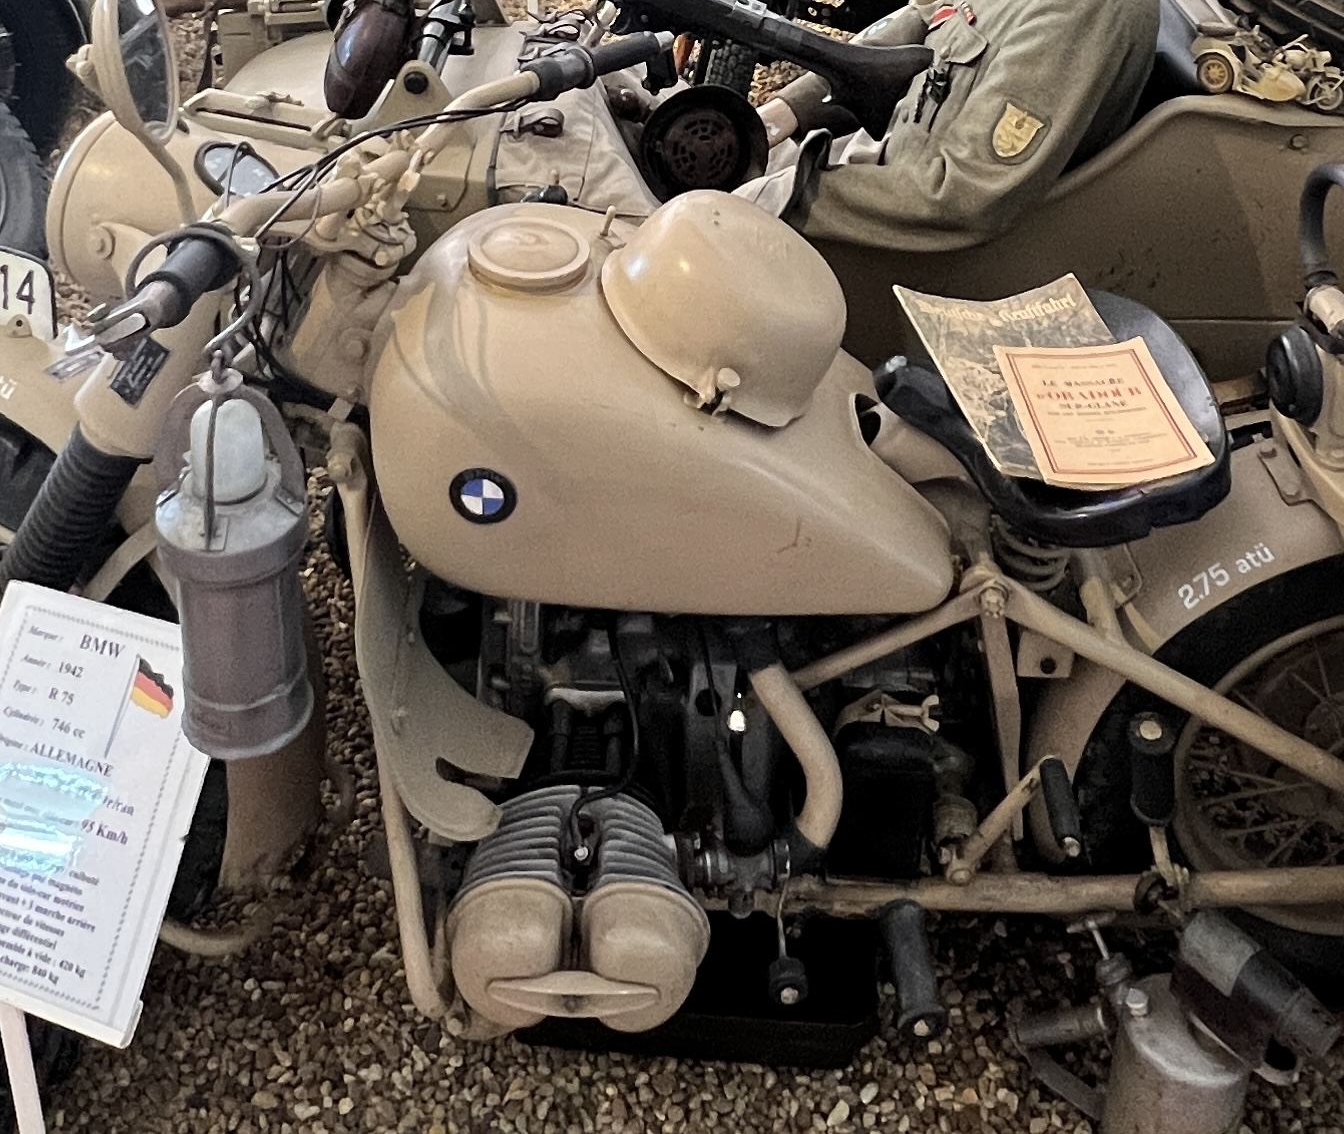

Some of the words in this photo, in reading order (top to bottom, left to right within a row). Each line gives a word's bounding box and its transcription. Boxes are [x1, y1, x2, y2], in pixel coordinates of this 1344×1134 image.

[1178, 562, 1230, 610] 2.75
[1235, 542, 1276, 574] atü
[79, 634, 126, 659] BMW
[59, 661, 84, 678] 1942
[48, 687, 58, 700] R
[61, 691, 75, 706] 75
[52, 718, 71, 734] 746
[73, 728, 86, 739] cc
[29, 742, 114, 778] ALLEMAGNE
[95, 823, 129, 846] Km/h
